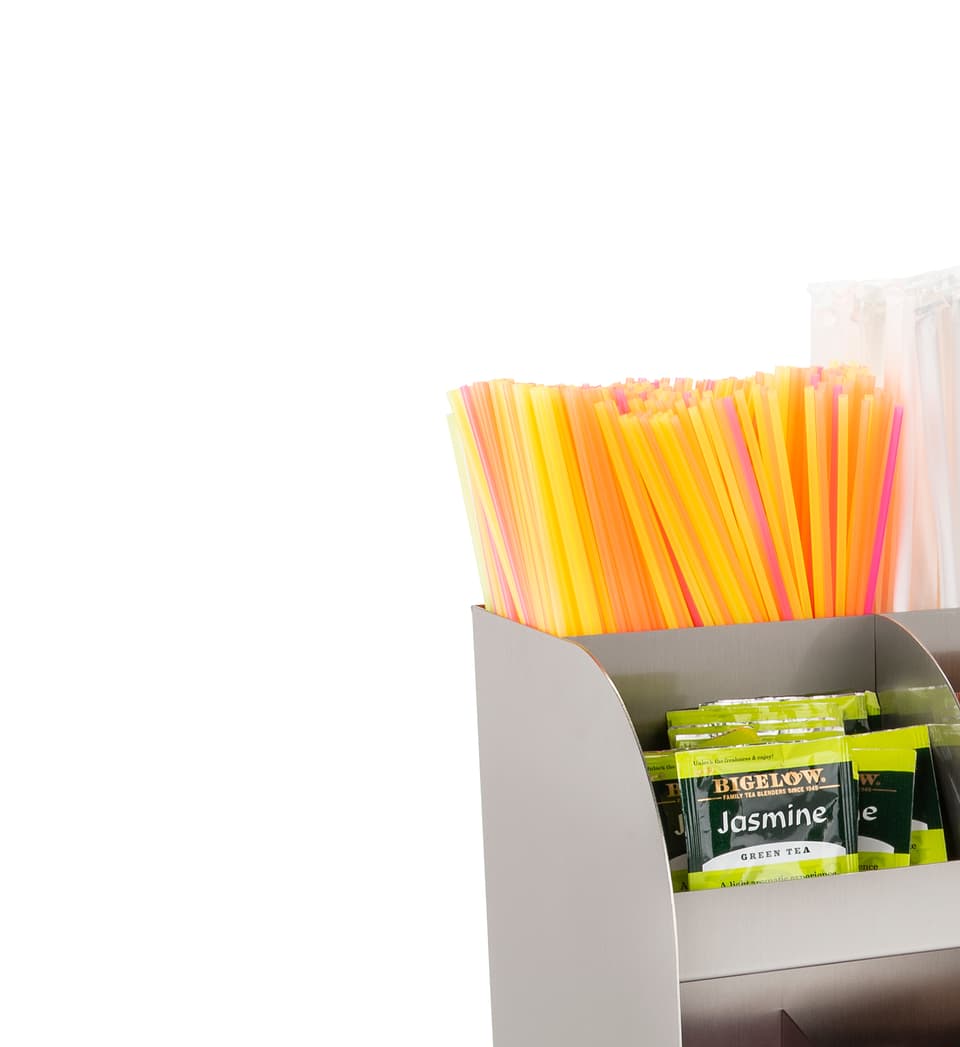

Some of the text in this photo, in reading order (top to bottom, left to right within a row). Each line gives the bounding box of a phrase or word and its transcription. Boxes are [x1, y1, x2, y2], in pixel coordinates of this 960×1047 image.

[756, 789, 787, 798] BLENDERS
[717, 804, 828, 834] Jasmine
[740, 846, 811, 861] GREEN TEA
